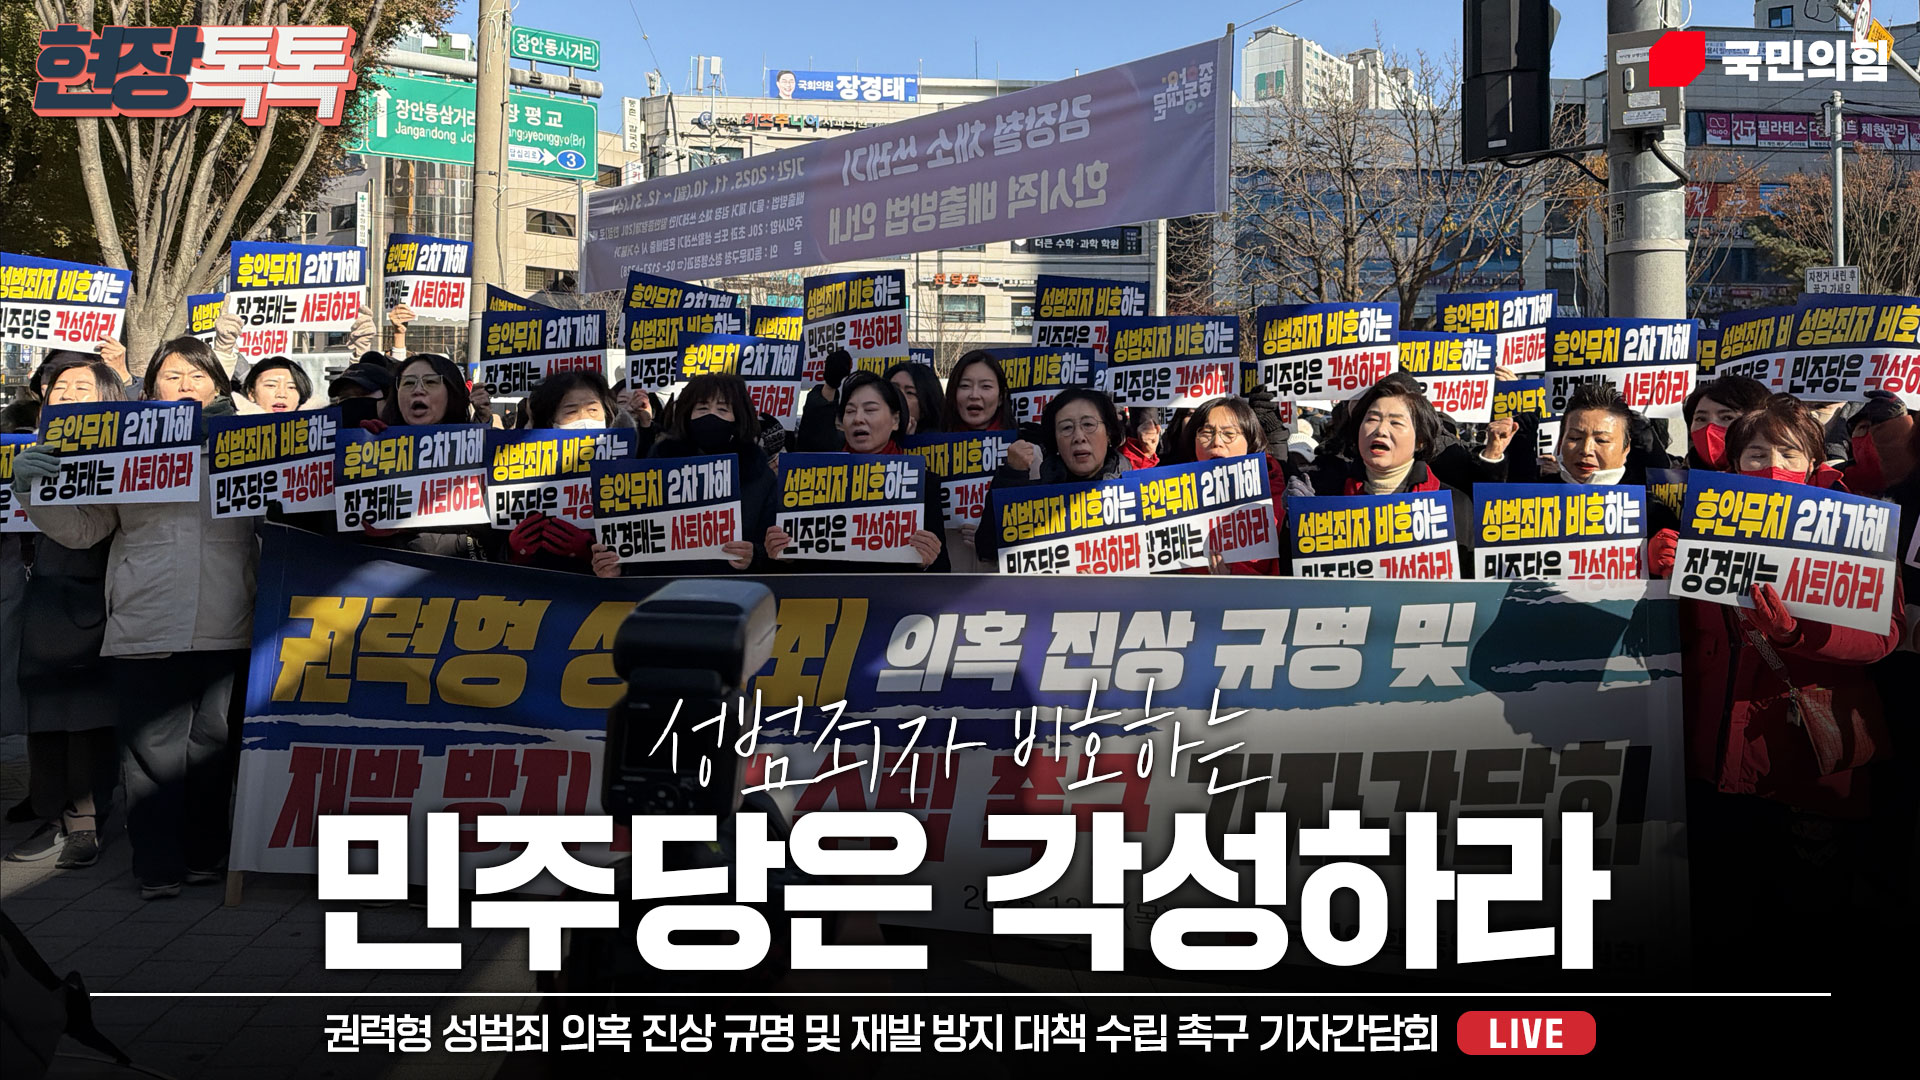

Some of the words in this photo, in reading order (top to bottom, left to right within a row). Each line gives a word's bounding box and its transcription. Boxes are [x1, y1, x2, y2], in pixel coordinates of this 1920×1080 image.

[516, 34, 595, 63] 장안동사거리
[798, 79, 834, 92] 국회의원
[836, 74, 905, 101] 장경태
[395, 121, 456, 144] Jangandong
[508, 128, 586, 149] angpyeonggyo(Br)
[1758, 121, 1808, 136] 필라테스
[566, 153, 577, 168] 3
[386, 242, 419, 272] 후안무치
[416, 243, 469, 274] 2차가해
[1102, 239, 1119, 249] 학원
[0, 265, 57, 301] 성범죄자
[60, 267, 124, 305] 비호하는
[237, 252, 302, 288] 후안무치
[304, 248, 360, 285] 2차가해
[1809, 270, 1830, 283] 자전거
[1833, 270, 1847, 282] 내린
[1849, 270, 1856, 280] 후
[236, 295, 297, 327] 장경태는
[301, 290, 361, 324] 사퇴하라
[410, 280, 465, 309] 사퇴하라
[629, 282, 682, 309] 후안무치
[807, 281, 846, 321] 성범죄자
[849, 276, 901, 310] 비호하는
[1040, 286, 1094, 318] 성범죄자
[1096, 285, 1145, 317] 비호하는
[1443, 299, 1500, 333] 후안무치
[1502, 293, 1552, 329] 2차가해
[54, 310, 117, 343] 각성하라
[238, 330, 288, 357] 각성하라
[487, 320, 543, 356] 후안무치
[545, 314, 600, 349] 2차가해
[630, 316, 683, 351] 성범죄자
[808, 323, 847, 356] 민주당은
[849, 312, 903, 349] 각성하라
[1037, 325, 1091, 347] 민주당은
[1114, 325, 1172, 363] 성범죄자
[1174, 320, 1235, 355] 비호하는
[1263, 315, 1323, 355] 성범죄자
[1326, 307, 1393, 347] 비호하는
[1552, 327, 1621, 368] 후안무치
[1623, 322, 1691, 362] 2차가해
[1720, 316, 1776, 360] 성범죄자
[1796, 306, 1876, 347] 성범죄자
[682, 344, 741, 378] 후안무치
[741, 343, 799, 377] 2차가해
[1033, 351, 1090, 386] 비호하는
[1264, 358, 1323, 398] 민주당은
[1327, 351, 1392, 391] 각성하라
[1432, 338, 1492, 373] 비호하는
[1789, 354, 1864, 394] 민주당은
[485, 361, 541, 395] 장경태는
[1113, 367, 1172, 404] 민주당은
[1174, 363, 1235, 399] 각성하라
[1432, 379, 1489, 413] 각성하라
[1623, 370, 1690, 407] 사퇴하라
[45, 411, 120, 452] 후안무치
[122, 404, 194, 446] 2차가해
[214, 423, 277, 469] 성범죄자
[281, 414, 337, 457] 비호하는
[119, 451, 194, 494] 사퇴하라
[343, 435, 414, 480] 후안무치
[417, 427, 484, 470] 2차가해
[493, 439, 559, 482] 성범죄자
[561, 433, 629, 475] 비호하는
[953, 436, 1012, 476] 비호하는
[216, 469, 278, 515] 민주당은
[281, 457, 336, 503] 각성하라
[344, 483, 412, 529] 장경태는
[417, 473, 486, 517] 사퇴하라
[599, 468, 663, 513] 후안무치
[667, 459, 732, 505] 2차가해
[783, 463, 848, 508] 성범죄자
[851, 460, 919, 503] 비호하는
[1200, 457, 1262, 508] 2차가해
[495, 487, 558, 527] 민주당은
[1002, 499, 1067, 543] 성범죄자
[1070, 485, 1137, 529] 비호하는
[1297, 506, 1371, 554] 성범죄자
[1375, 498, 1449, 546] 비호하는
[1482, 495, 1562, 543] 성범죄자
[1565, 490, 1641, 537] 비호하는
[1691, 488, 1793, 541] 후안무치
[1791, 497, 1891, 553] 2차가해
[600, 518, 666, 559] 장경태는
[670, 507, 736, 552] 사퇴하라
[782, 513, 847, 554] 민주당은
[851, 509, 918, 551] 각성하라
[1208, 506, 1271, 554] 사퇴하라
[1006, 543, 1071, 574] 민주당은
[1075, 532, 1141, 575] 각성하라
[1484, 550, 1562, 580] 민주당은
[1568, 546, 1641, 580] 각성하라
[1681, 547, 1779, 597] 장경태는
[1781, 556, 1885, 613] 사퇴하라
[272, 595, 551, 709] 권력형
[876, 611, 1025, 695] 의혹
[1036, 608, 1198, 693] 진상
[1204, 607, 1370, 693] 규명
[1390, 602, 1476, 690] 및
